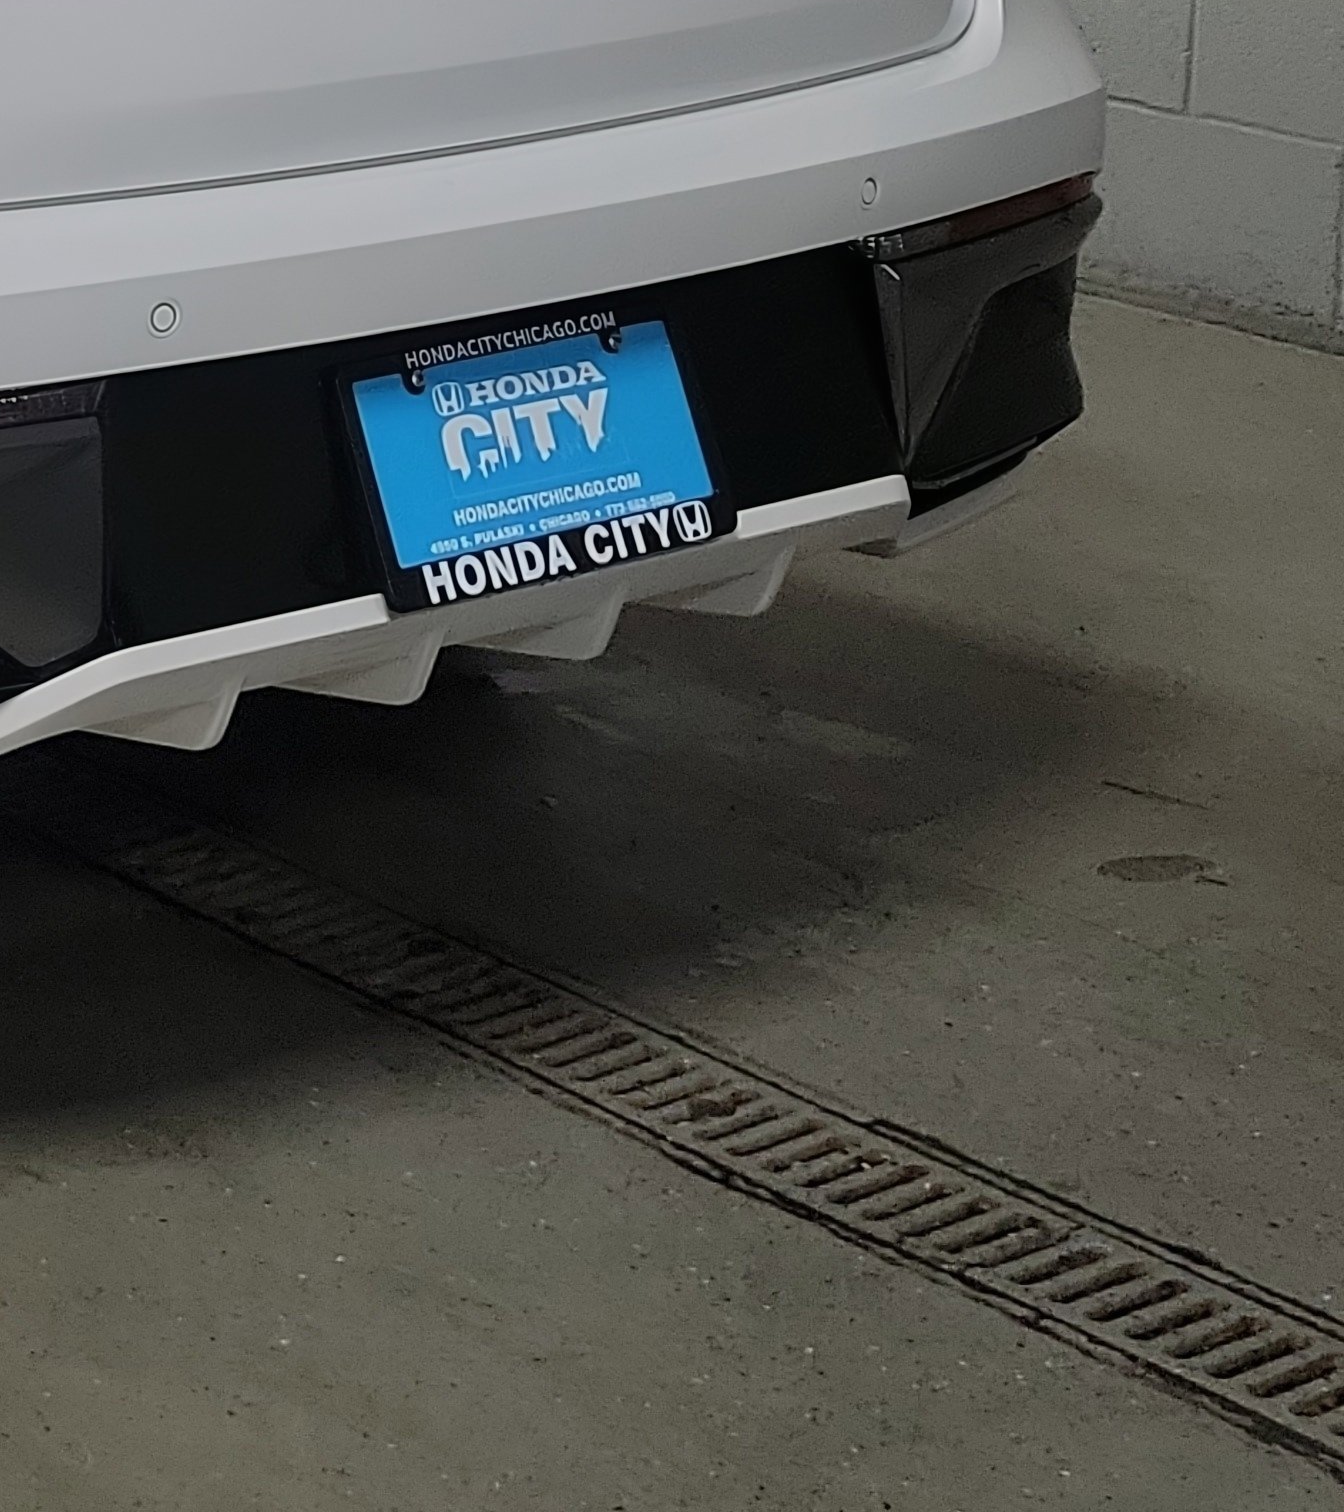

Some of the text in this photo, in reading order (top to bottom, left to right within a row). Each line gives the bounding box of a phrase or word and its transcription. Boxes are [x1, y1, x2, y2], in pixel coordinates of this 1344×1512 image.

[404, 310, 617, 369] HONDACITYCHICAGO.COM
[464, 360, 607, 407] HONDA
[440, 387, 609, 483] CITY
[453, 471, 642, 527] HONDACITYCHICAGO.COM
[421, 507, 671, 605] HONDA CITY
